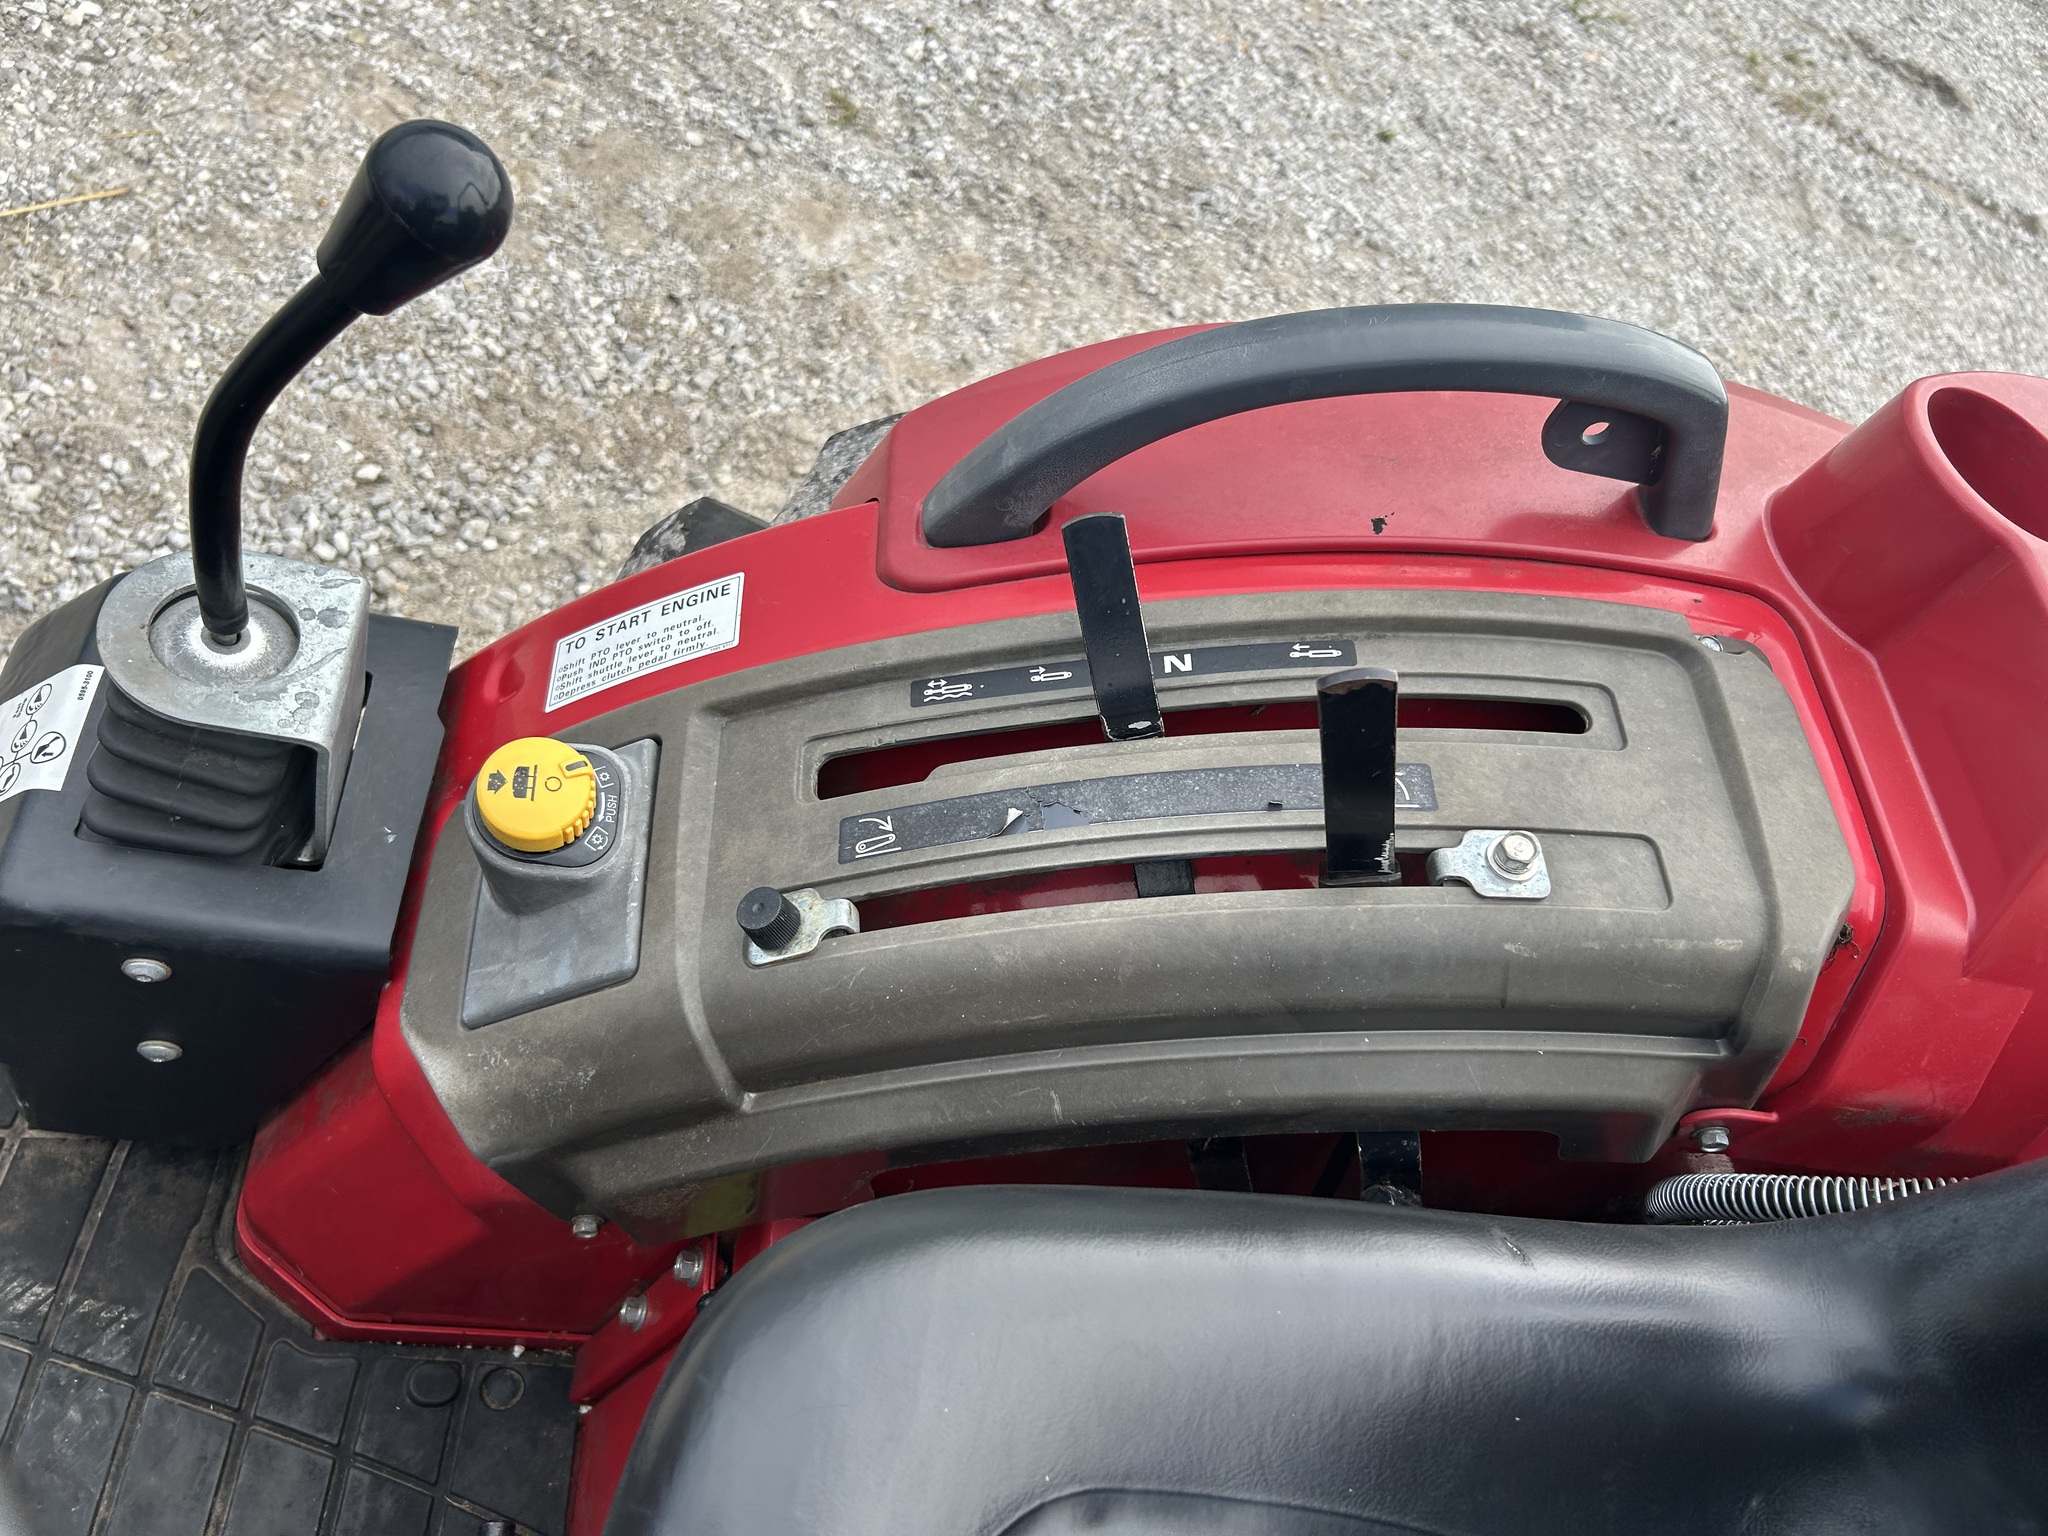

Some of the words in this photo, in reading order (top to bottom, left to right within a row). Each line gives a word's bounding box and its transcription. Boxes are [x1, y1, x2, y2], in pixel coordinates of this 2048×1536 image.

[563, 656, 586, 672] Shift
[590, 647, 610, 661] PTO
[616, 636, 641, 651] lever
[647, 630, 657, 640] to
[663, 614, 705, 633] neutral.
[566, 636, 586, 654] TO
[595, 610, 651, 642] START
[661, 583, 731, 617] ENGINE
[558, 675, 583, 691] Shift
[588, 660, 623, 679] shuttle
[628, 649, 654, 664] lever
[660, 642, 671, 652] to
[558, 680, 596, 700] Depress
[602, 664, 633, 681] clutch
[638, 652, 668, 671] pedal
[560, 666, 584, 682] Push
[588, 657, 607, 670] IND
[612, 647, 632, 661] PTO
[638, 633, 673, 650] switch
[679, 627, 690, 637] to
[1163, 653, 1193, 674] N
[605, 794, 618, 823] PUSH
